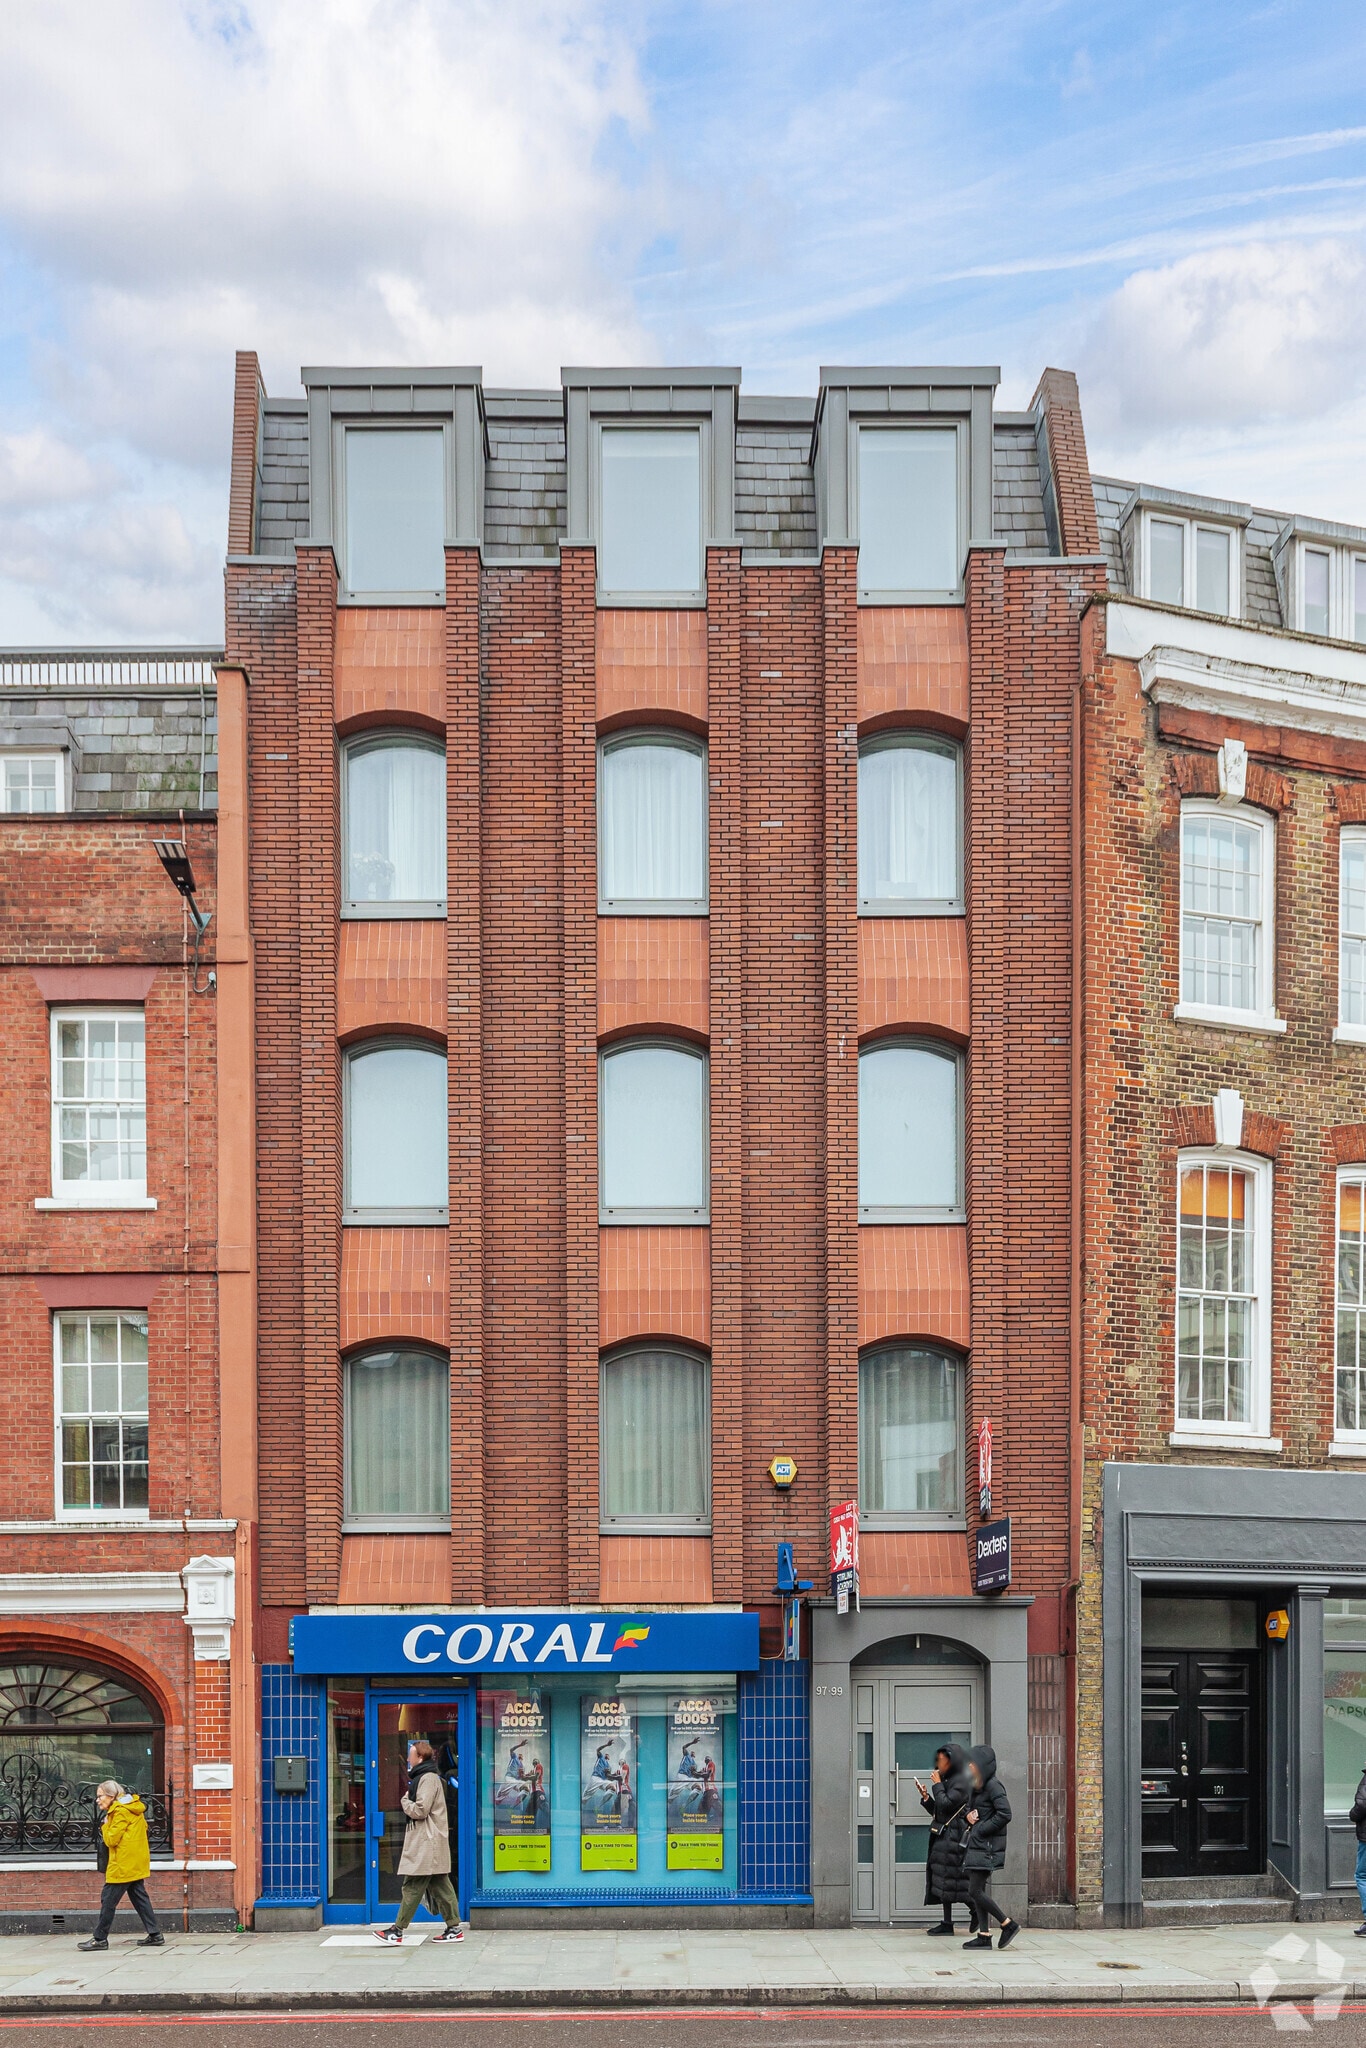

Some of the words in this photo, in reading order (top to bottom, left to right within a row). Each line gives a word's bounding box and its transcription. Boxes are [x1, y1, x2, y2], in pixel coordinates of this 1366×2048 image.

[776, 1466, 790, 1474] ADT
[978, 1536, 1007, 1559] Dexters
[402, 1622, 614, 1664] CORAL
[505, 1702, 540, 1714] ACCA
[592, 1703, 627, 1714] ACCA
[678, 1700, 712, 1711] ACCA
[501, 1716, 544, 1727] BOOST
[588, 1716, 630, 1726] BOOST
[674, 1713, 716, 1724] BOOST
[1214, 1785, 1224, 1795] 101
